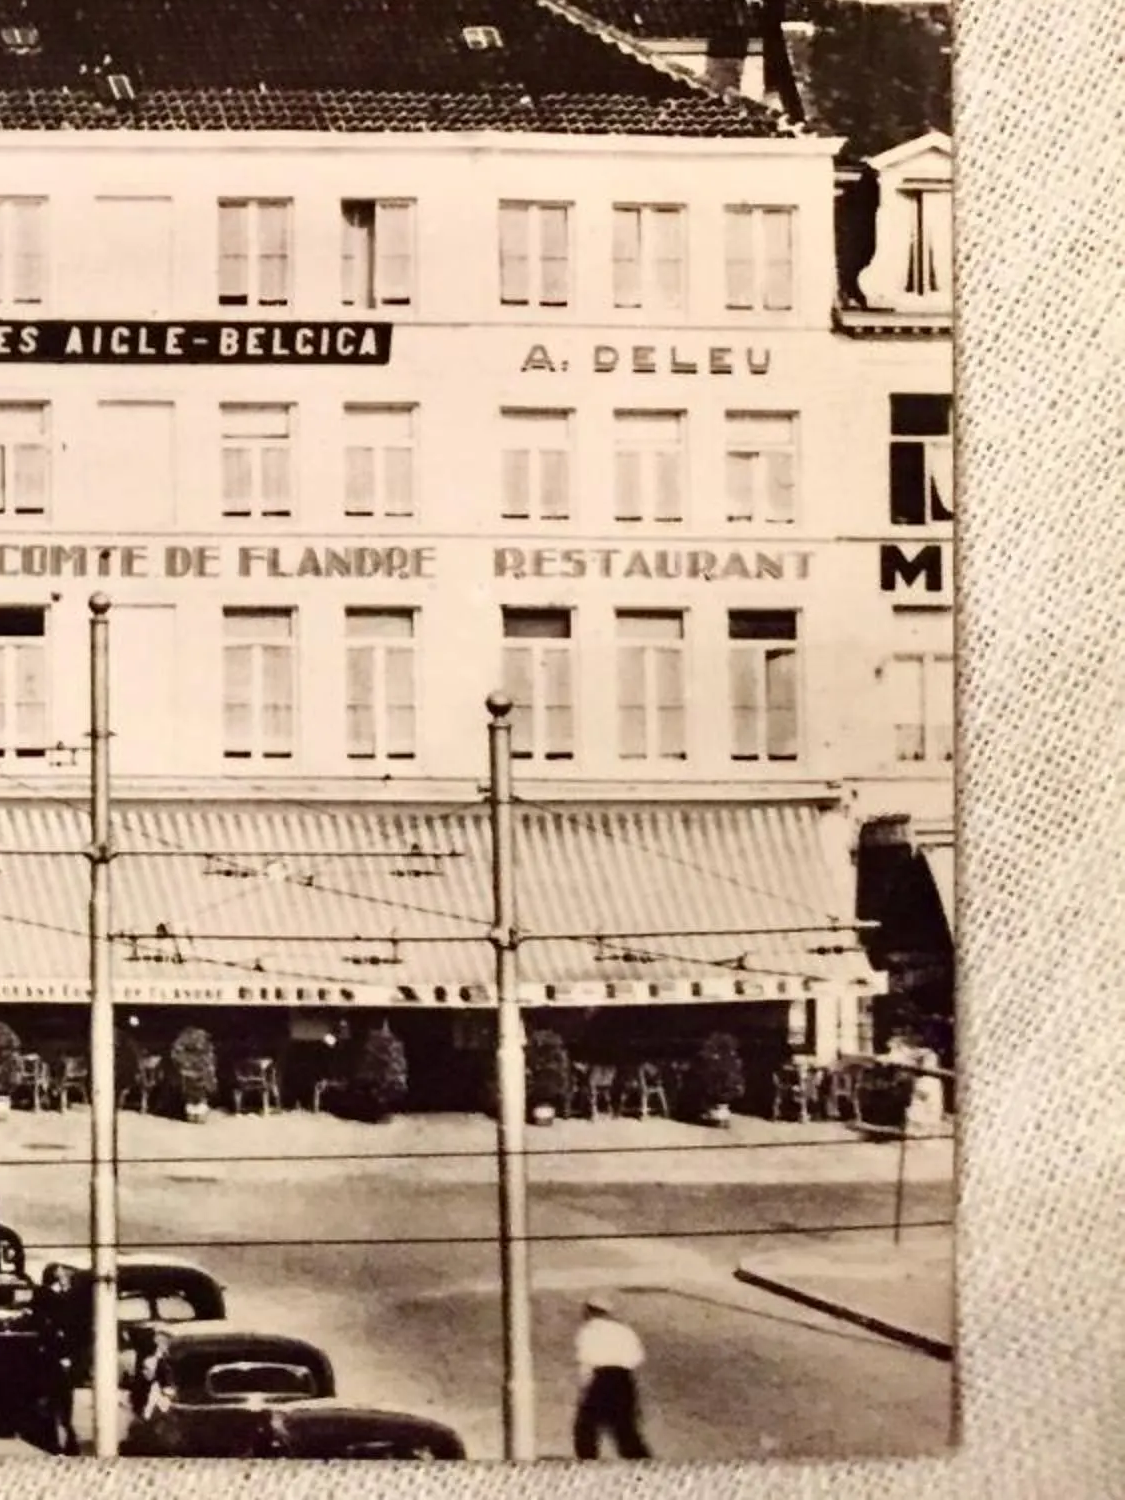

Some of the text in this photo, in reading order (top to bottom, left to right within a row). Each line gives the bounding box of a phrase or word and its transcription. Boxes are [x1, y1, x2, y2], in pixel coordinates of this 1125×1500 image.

[520, 344, 772, 375] A. DELEU
[164, 546, 221, 578] DE
[237, 546, 438, 579] FLANDRE
[493, 547, 817, 581] RESTAURANT
[880, 544, 943, 592] M
